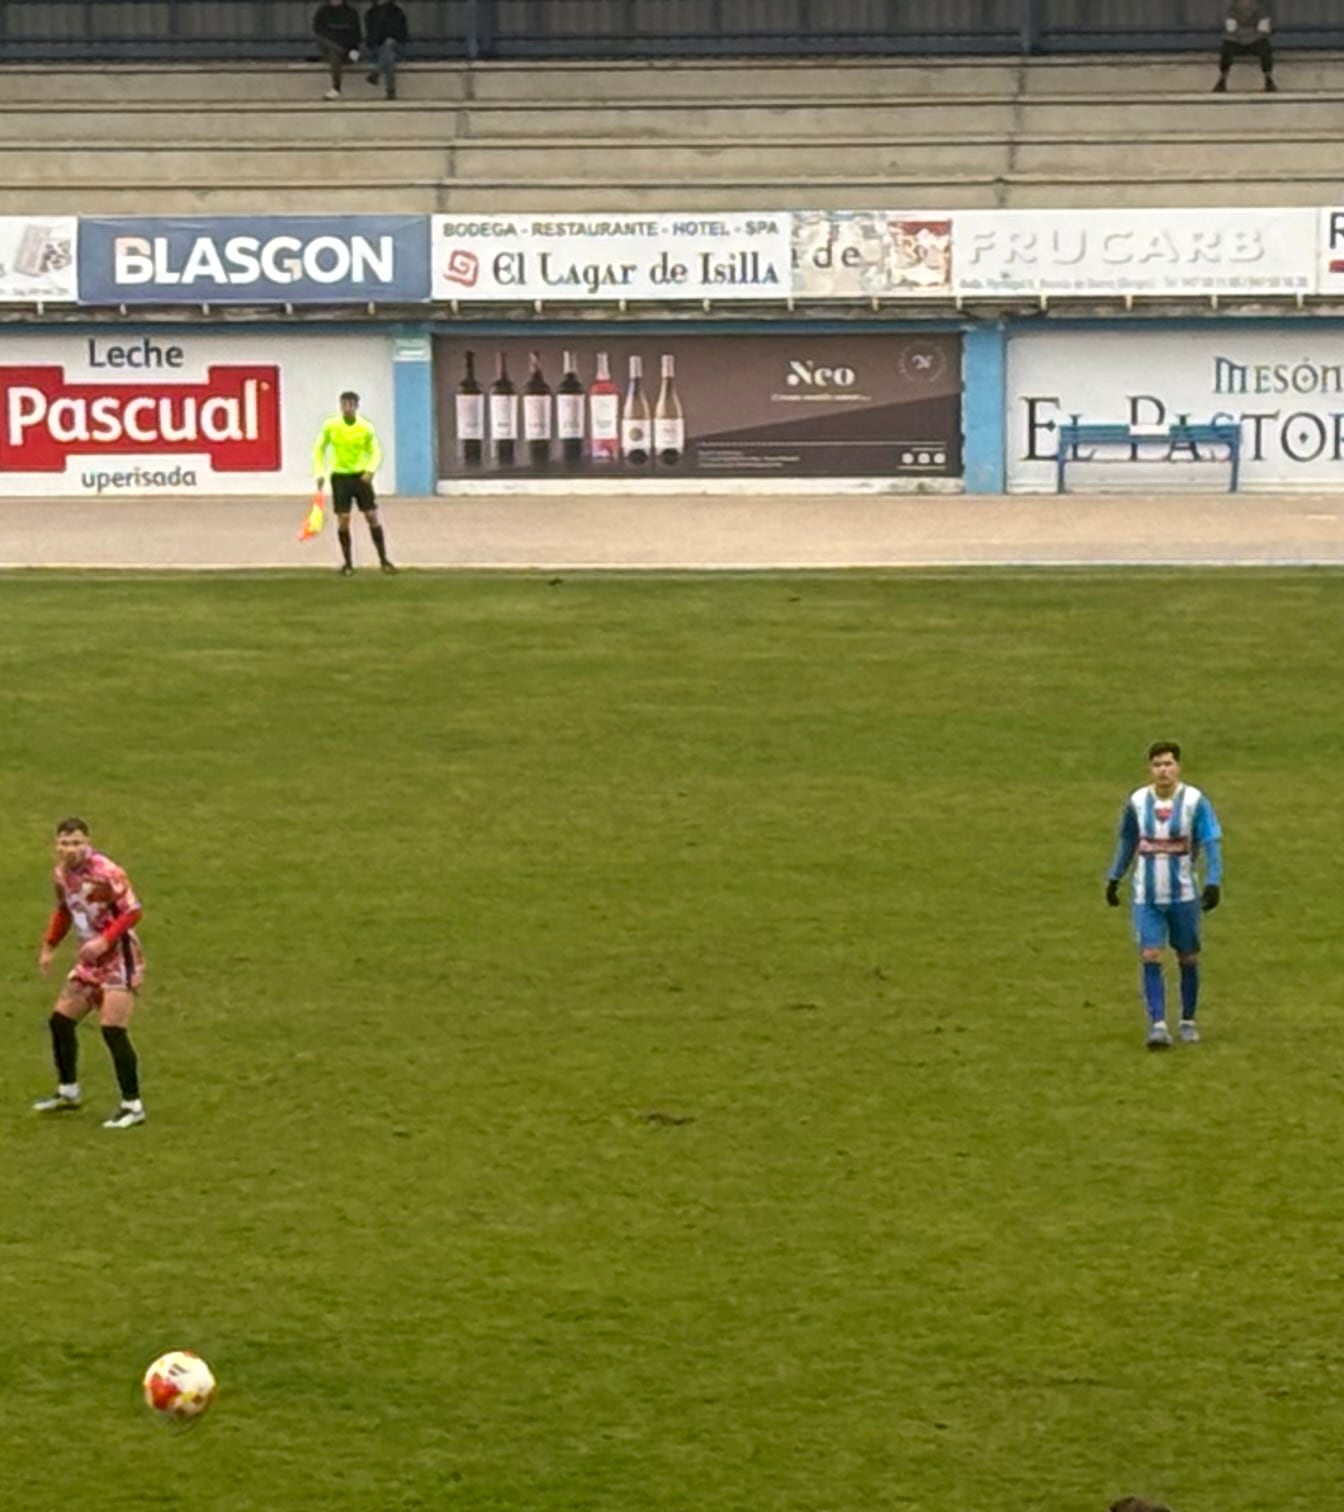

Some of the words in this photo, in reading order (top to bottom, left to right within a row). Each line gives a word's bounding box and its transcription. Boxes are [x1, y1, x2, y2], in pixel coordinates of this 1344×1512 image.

[443, 222, 516, 237] BODEGA
[531, 222, 659, 237] RESTAURANTE
[672, 221, 731, 236] HOTEL
[745, 220, 779, 236] SPA
[113, 235, 394, 285] BLASGON
[493, 252, 525, 285] El
[539, 254, 639, 295] Lagar
[649, 252, 687, 285] de
[700, 250, 780, 285] Isilla
[87, 337, 184, 369] Leche
[6, 379, 260, 447] Pascual
[81, 466, 197, 493] uperisada
